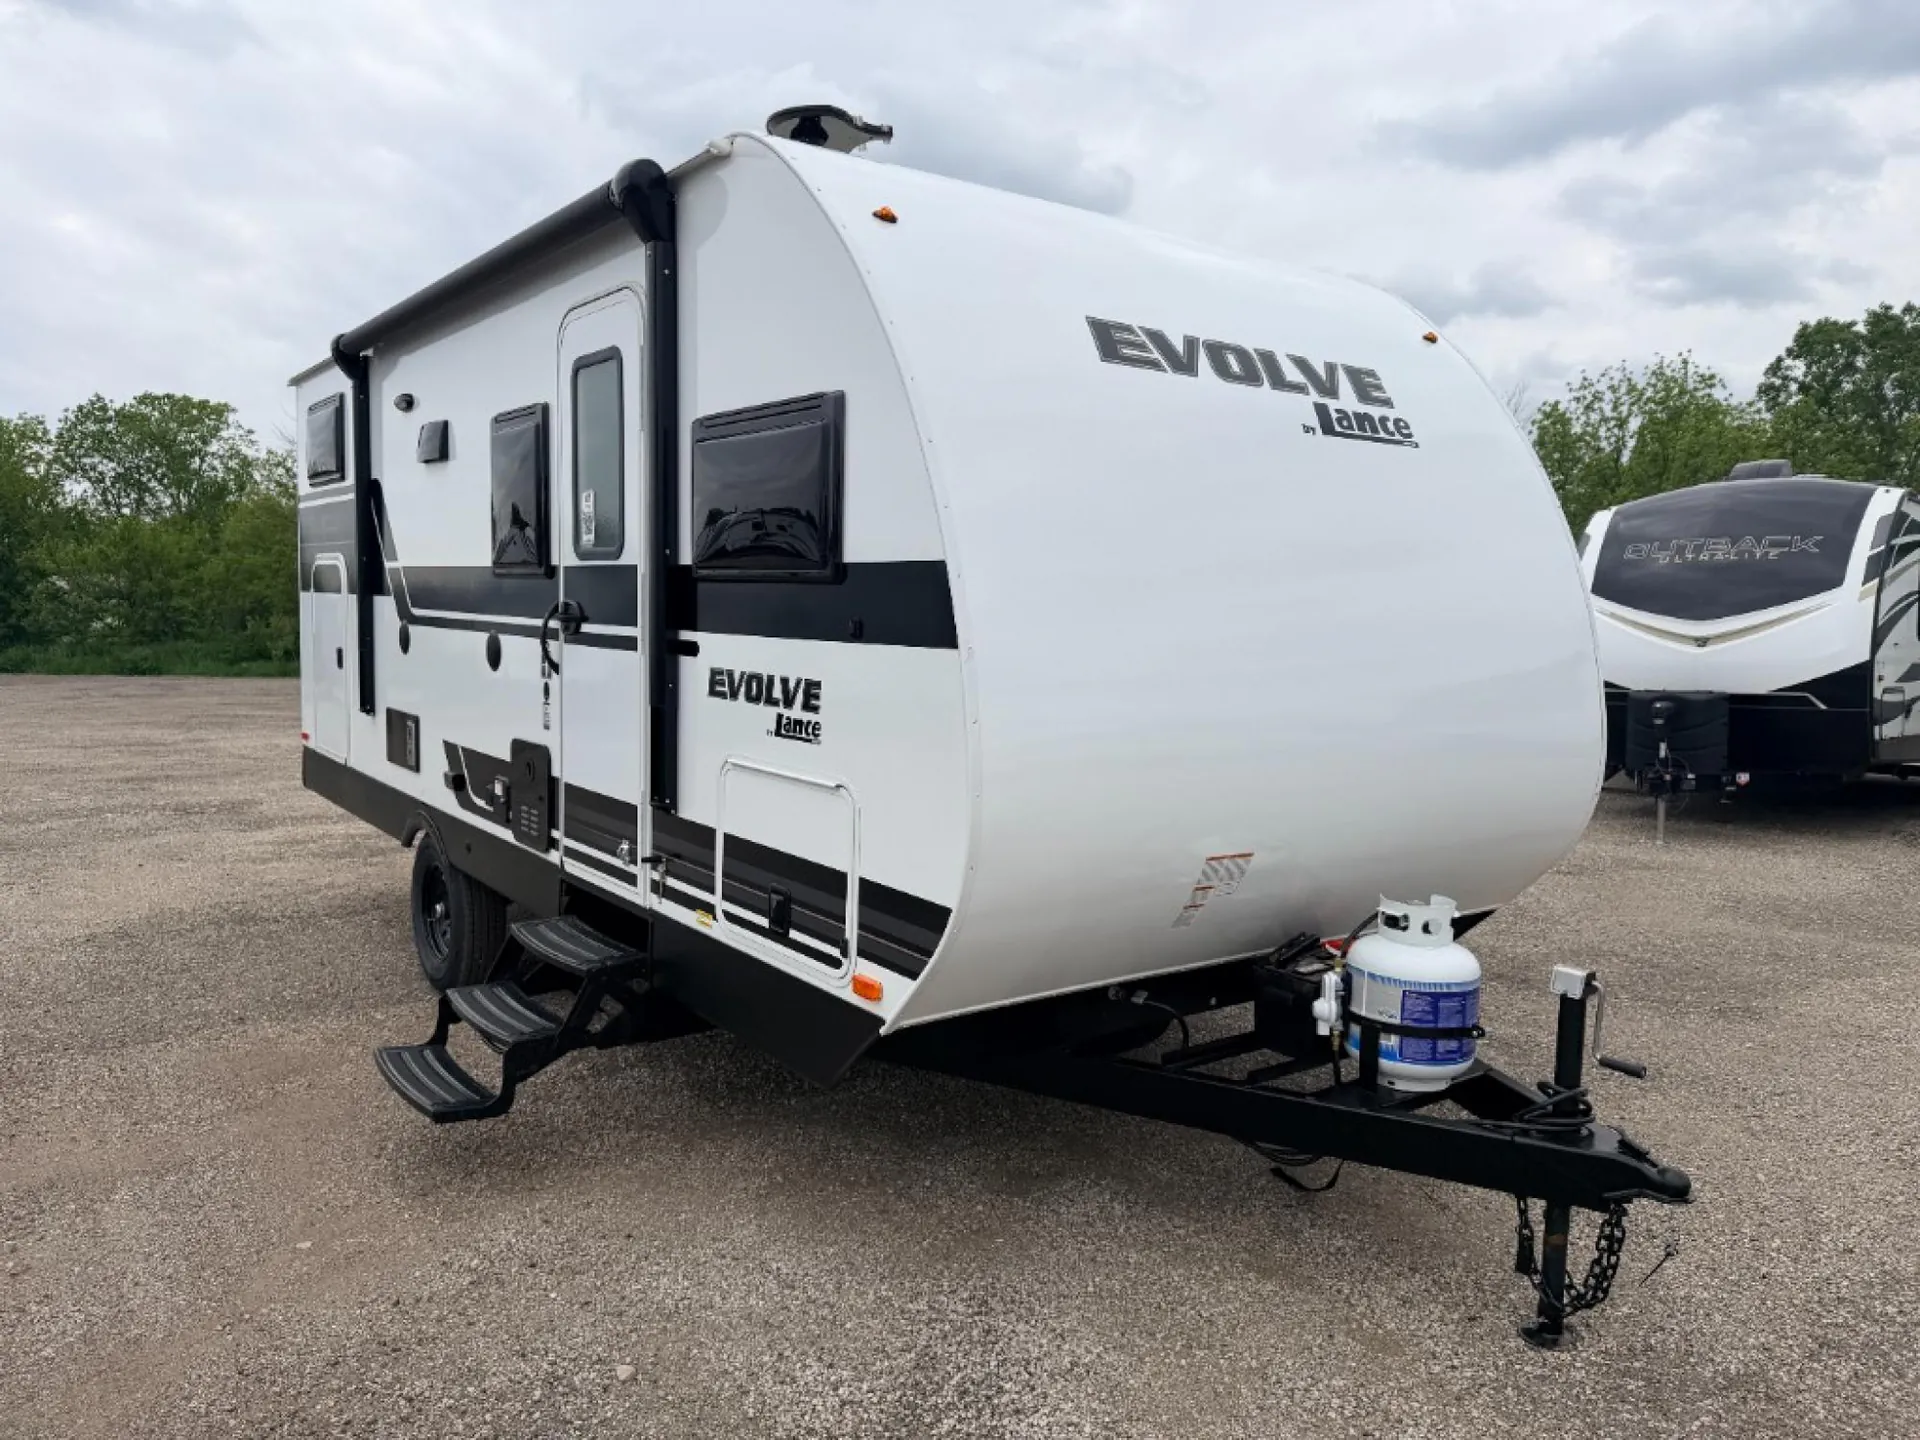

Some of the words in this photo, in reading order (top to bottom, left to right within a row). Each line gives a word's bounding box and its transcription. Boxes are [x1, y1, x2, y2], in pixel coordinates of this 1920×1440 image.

[1086, 315, 1394, 408] EVOLVE
[1313, 401, 1416, 443] Lance
[1623, 536, 1824, 560] OUTBACK
[708, 667, 822, 714] EVOLVE
[774, 712, 822, 743] Lance
